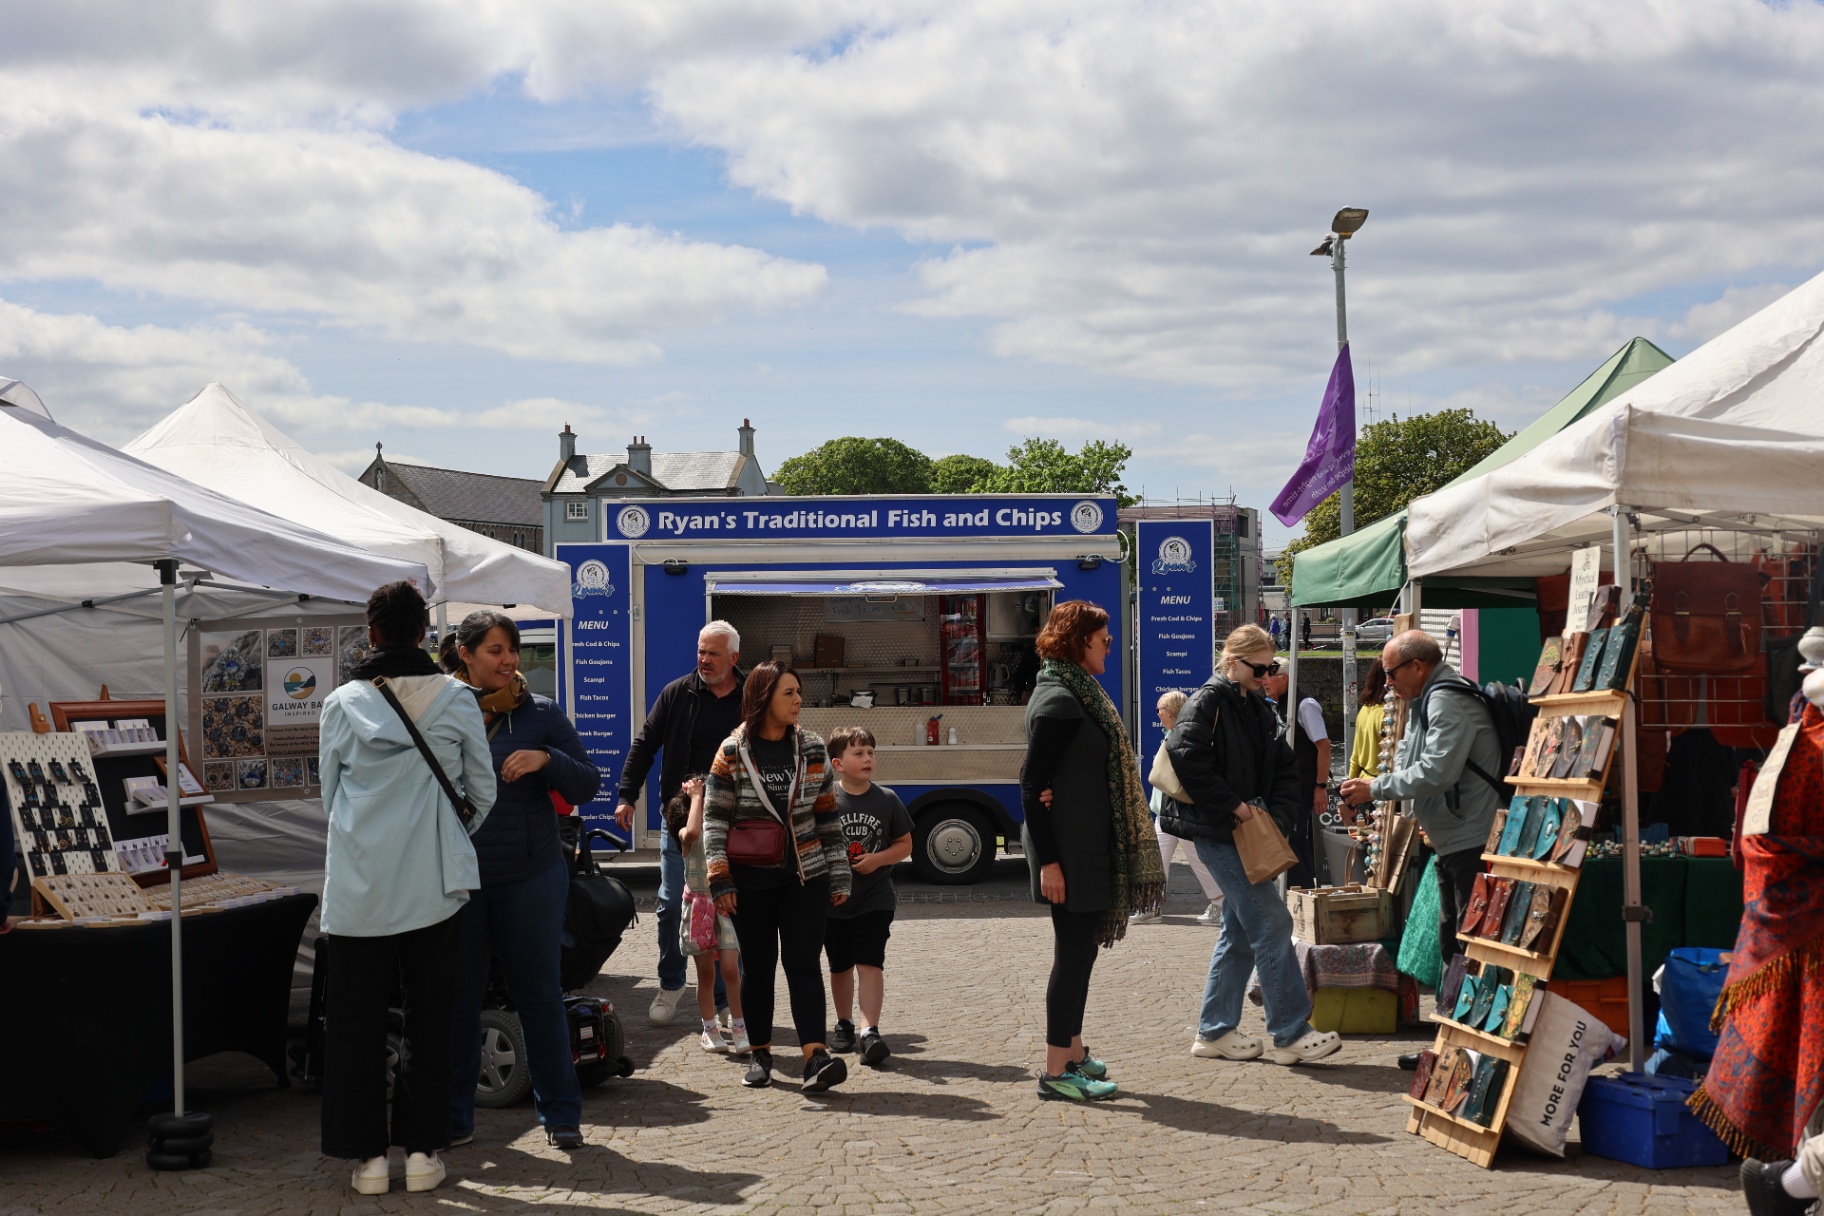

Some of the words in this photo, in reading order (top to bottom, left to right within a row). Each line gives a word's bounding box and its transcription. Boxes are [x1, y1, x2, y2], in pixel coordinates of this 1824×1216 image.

[658, 511, 737, 535] Ryan's
[743, 509, 877, 529] Traditional
[887, 509, 937, 528] Fish
[943, 508, 990, 527] and
[995, 507, 1062, 531] Chips
[1160, 595, 1191, 605] MENU
[577, 620, 609, 630] MENU
[603, 640, 620, 648] Chips
[583, 676, 605, 684] Scampi
[272, 701, 308, 711] GALWAY
[596, 712, 617, 720] burger
[593, 730, 613, 738] Burger
[595, 748, 620, 756] Sausage
[597, 766, 611, 774] hips
[758, 769, 785, 783] New
[784, 768, 797, 783] Yo
[767, 783, 789, 792] Since
[580, 813, 598, 822] gular
[598, 813, 616, 822] Chips
[846, 826, 868, 836] CLUB
[1540, 1084, 1565, 1127] MORE
[1557, 1053, 1576, 1083] FOR
[1569, 1020, 1587, 1049] YOU
